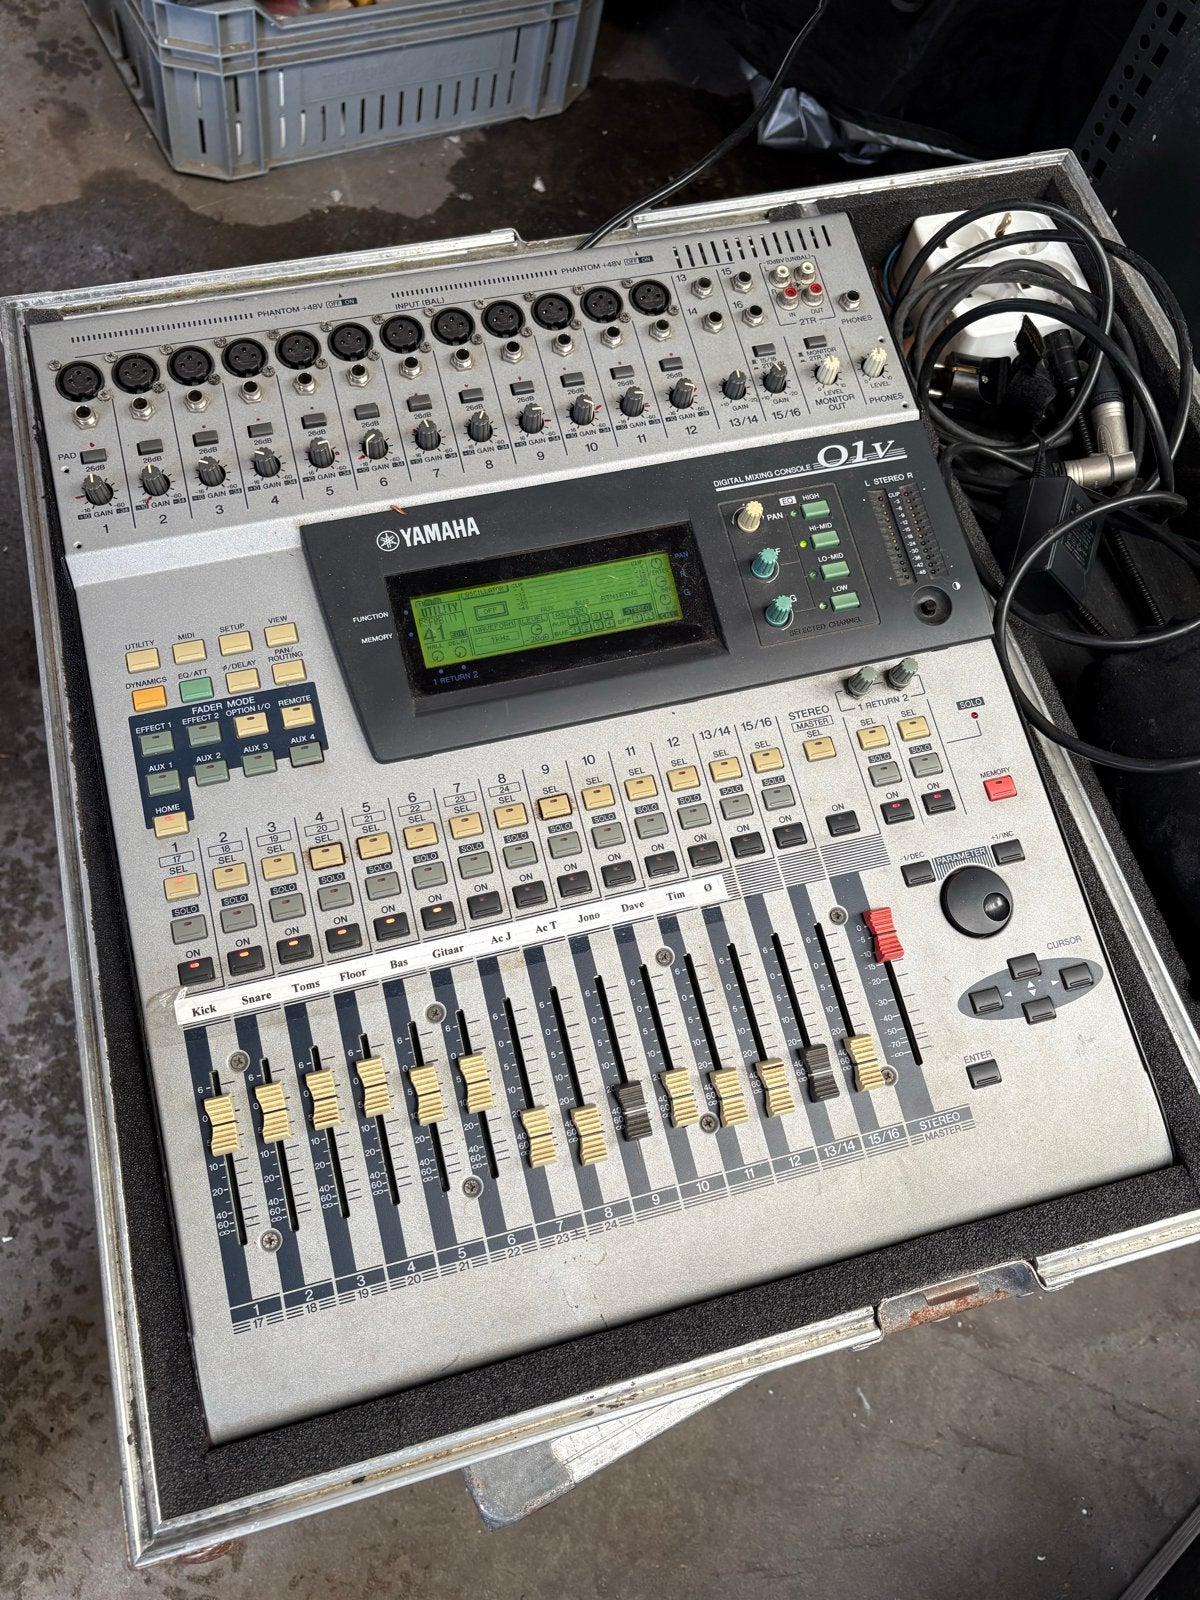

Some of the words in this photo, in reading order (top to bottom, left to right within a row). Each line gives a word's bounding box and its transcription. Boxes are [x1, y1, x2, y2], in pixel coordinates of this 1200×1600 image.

[561, 264, 600, 274] PHANTOM
[602, 260, 621, 268] +48V
[676, 274, 687, 282] 13
[395, 301, 420, 309] INPUT
[421, 297, 444, 307] (BAL)
[257, 307, 300, 317] PHANTOM
[302, 303, 323, 312] +48V
[687, 308, 698, 316] 14
[799, 317, 816, 325] 2TR
[841, 315, 872, 325] PHONES
[666, 372, 683, 380] 26dB
[824, 388, 843, 396] LEVEL
[815, 394, 854, 406] MONITOR
[869, 392, 904, 404] PHONES
[829, 402, 846, 411] OUT
[772, 408, 800, 420] 15/16
[729, 415, 758, 427] 13/14
[685, 426, 698, 435] 12
[637, 434, 646, 443] 11
[585, 442, 598, 452] 10
[58, 452, 76, 460] PAD
[537, 452, 544, 460] 9
[485, 460, 493, 469] 8
[433, 468, 440, 477] 7
[713, 477, 744, 487] DIGITAL
[745, 470, 773, 481] MIXING
[775, 464, 811, 476] CONSOLE
[380, 477, 388, 486] 6
[873, 475, 905, 485] STEREO
[326, 486, 334, 495] 5
[271, 496, 279, 504] 4
[94, 509, 113, 517] GAIN
[215, 505, 224, 514] 3
[160, 515, 167, 524] 2
[767, 512, 783, 521] PAN
[103, 525, 109, 533] 1
[400, 517, 480, 547] YAMAHA
[809, 523, 832, 531] HI-MID
[818, 553, 843, 562] LO-MID
[422, 602, 458, 617] UTILITY
[353, 612, 388, 623] FUNCTION
[220, 623, 245, 632] SETUP
[790, 624, 825, 636] SELECTED
[829, 616, 862, 628] CHANNEL
[424, 625, 445, 640] 41
[361, 633, 393, 644] MEMORY
[125, 640, 154, 650] UTILITY
[275, 647, 293, 655] PAN/
[268, 651, 303, 662] ROUTING
[178, 669, 208, 679] EQ/ATT
[440, 674, 471, 684] RETURN
[126, 677, 167, 689] DYNAMICS
[192, 703, 223, 714] FADER
[227, 697, 255, 707] MODE
[278, 695, 311, 706] REMOTE
[866, 696, 899, 709] RETURN
[960, 699, 982, 708] SOLO
[226, 705, 255, 717] OPTION
[789, 706, 829, 720] STEREO
[182, 715, 212, 725] EFFECT
[741, 718, 772, 731] 15/16
[796, 718, 829, 730] MASTER
[860, 718, 876, 726] SEL
[136, 723, 166, 734] EFFECT
[700, 727, 730, 740] 13/14
[291, 736, 307, 744] AUX
[667, 738, 680, 747] 12
[243, 745, 259, 753] AUX
[625, 747, 635, 756] 11
[196, 754, 212, 763] AUX
[582, 755, 595, 765] 10
[149, 764, 165, 772] AUX
[541, 765, 549, 774] 9
[980, 767, 1010, 778] MEMORY
[498, 774, 506, 783] 8
[454, 783, 460, 792] 7
[408, 793, 417, 802] 6
[886, 791, 899, 799] ON
[156, 804, 180, 814] HOME
[362, 802, 370, 812] 5
[315, 812, 323, 821] 4
[268, 822, 276, 832] 3
[219, 832, 227, 842] 2
[173, 843, 178, 851] 1
[936, 849, 986, 864] PARAMETER
[169, 866, 187, 874] SEL
[666, 890, 685, 900] Tim
[175, 906, 197, 916] SOLO
[621, 901, 644, 912] Dave
[578, 912, 600, 923] Jono
[536, 925, 547, 933] Ac
[549, 922, 557, 930] T
[491, 936, 504, 944] Ac
[505, 933, 511, 941] J
[1047, 935, 1082, 950] CURSOR
[186, 949, 200, 958] ON
[432, 945, 464, 959] Gitaar
[390, 959, 408, 969] Bas
[339, 969, 366, 981] Floor
[292, 981, 320, 993] Toms
[242, 991, 272, 1005] Snare
[192, 1004, 216, 1017] Kick
[964, 1050, 992, 1063] ENTER
[920, 1112, 960, 1130] STEREO
[868, 1128, 899, 1144] 15/16
[924, 1124, 962, 1142] MASTER
[824, 1141, 855, 1157] 13/14
[788, 1156, 802, 1166] 12
[744, 1169, 755, 1178] 11
[696, 1181, 709, 1191] 10
[652, 1194, 660, 1204] 9
[604, 1208, 613, 1218] 8
[556, 1221, 564, 1230] 7
[508, 1234, 516, 1244] 6
[458, 1248, 466, 1258] 5
[407, 1262, 416, 1271] 4
[357, 1276, 365, 1286] 3
[305, 1290, 314, 1300] 2
[254, 1305, 259, 1314] 1
[253, 1318, 263, 1328] 17
